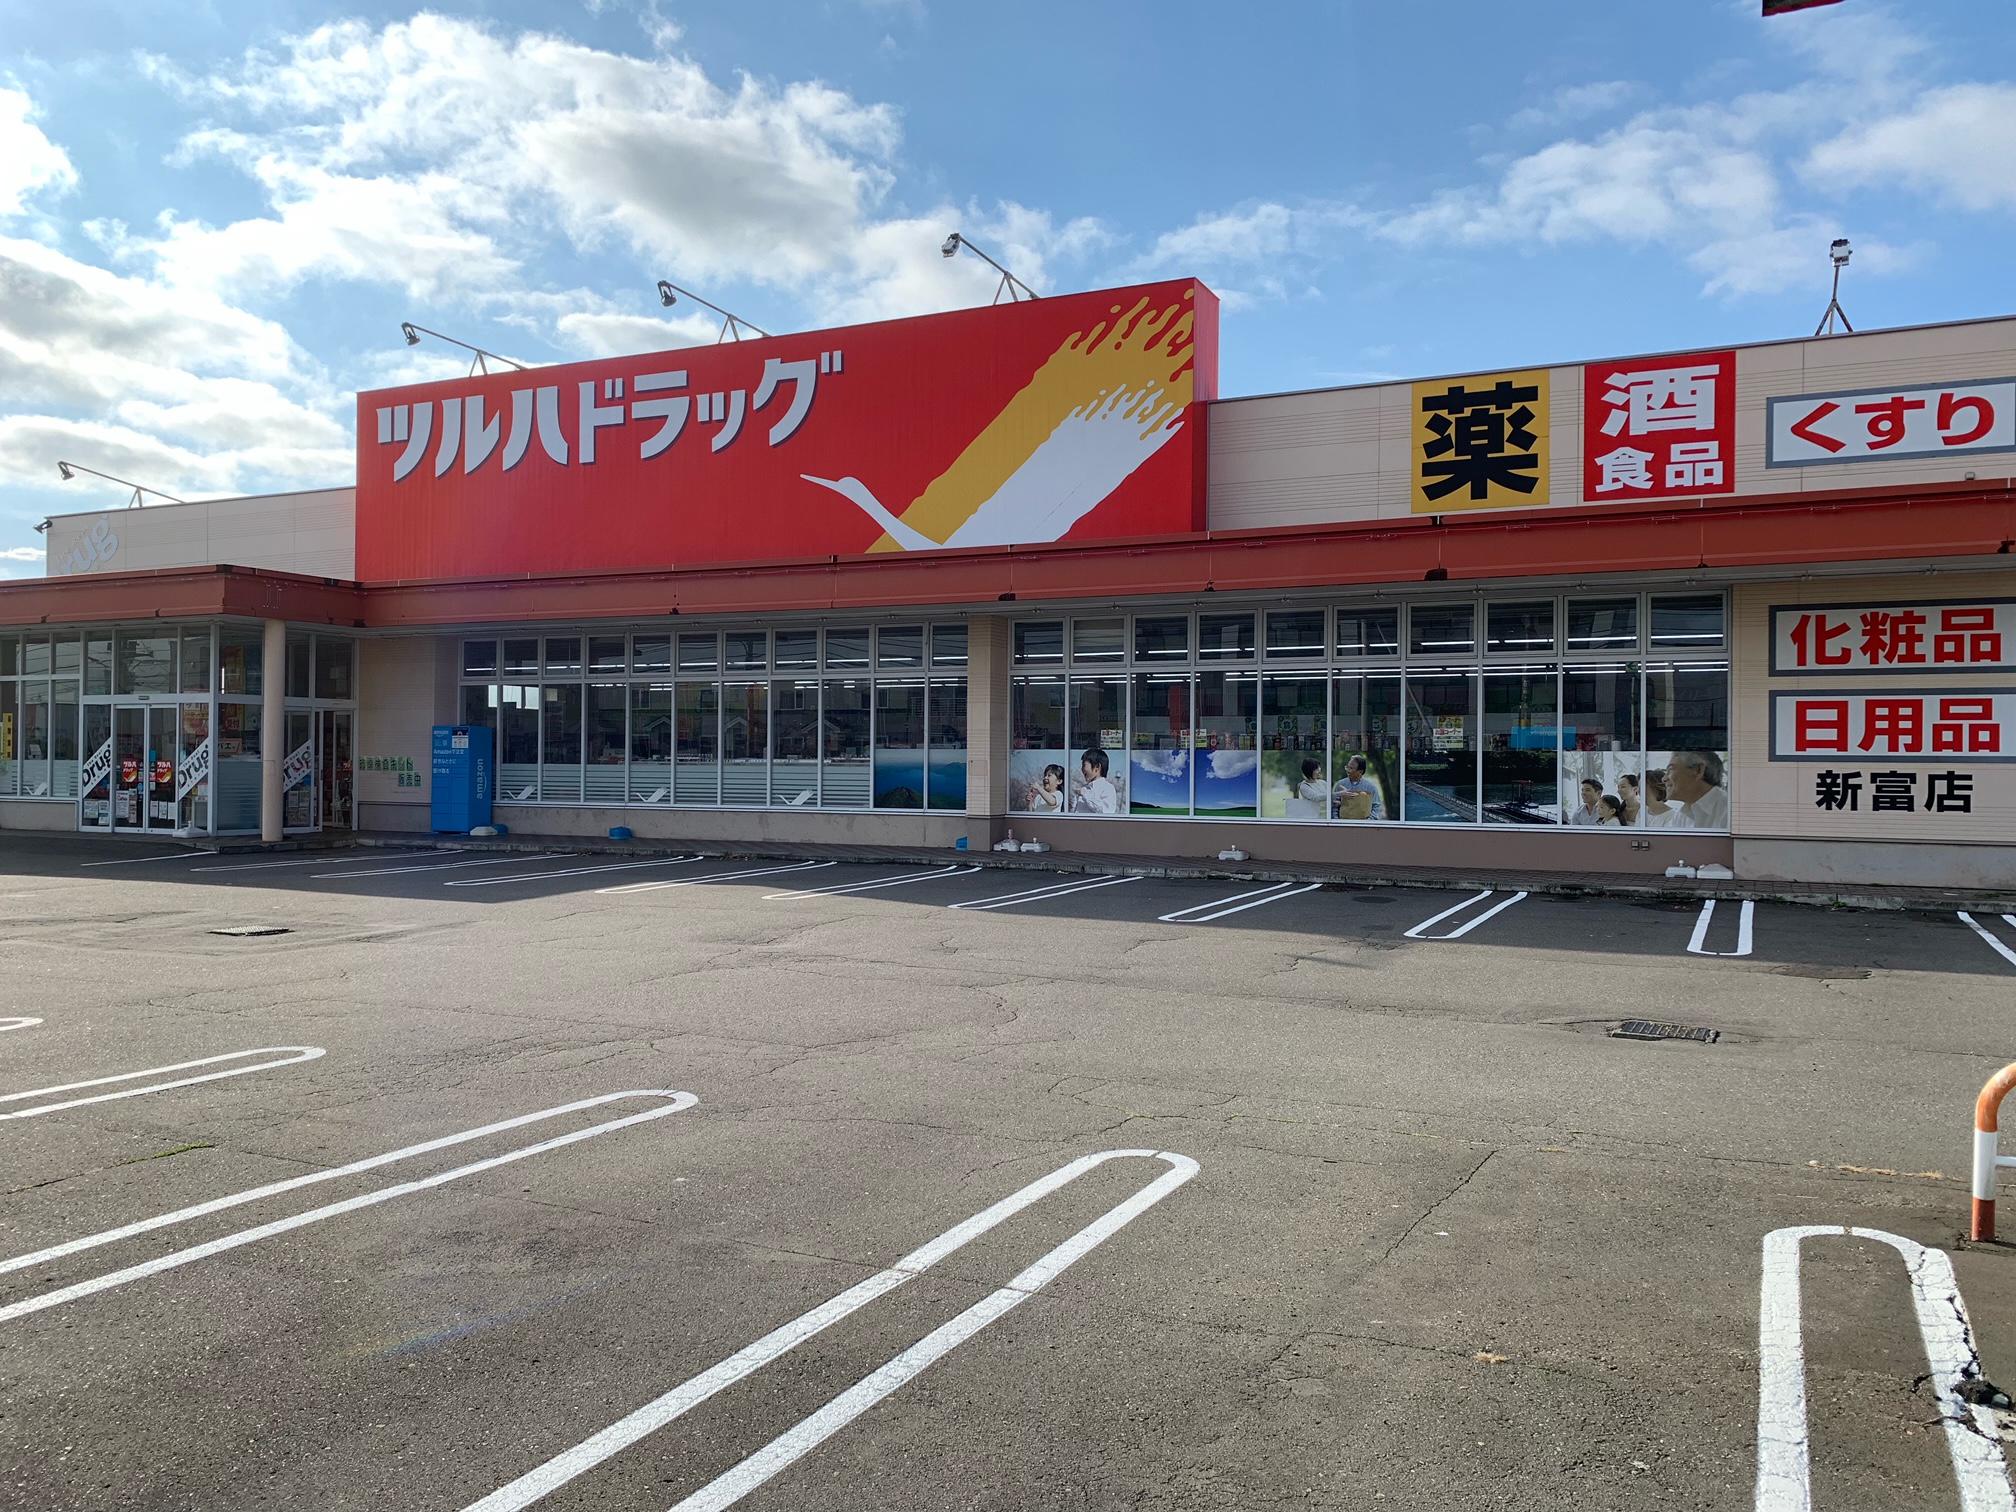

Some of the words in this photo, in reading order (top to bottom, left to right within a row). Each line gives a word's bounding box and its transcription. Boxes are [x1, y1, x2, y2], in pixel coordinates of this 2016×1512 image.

[376, 350, 844, 483] ツルハドラッグ
[1600, 363, 1721, 438] 酒
[1790, 392, 1995, 453] くすり
[1421, 381, 1539, 501] 薬
[1595, 440, 1724, 494] 食品
[1790, 608, 2002, 667] 化粧品
[1794, 698, 2001, 753] 日用品
[477, 758, 485, 799] amazon
[1815, 769, 1974, 813] 新富店
